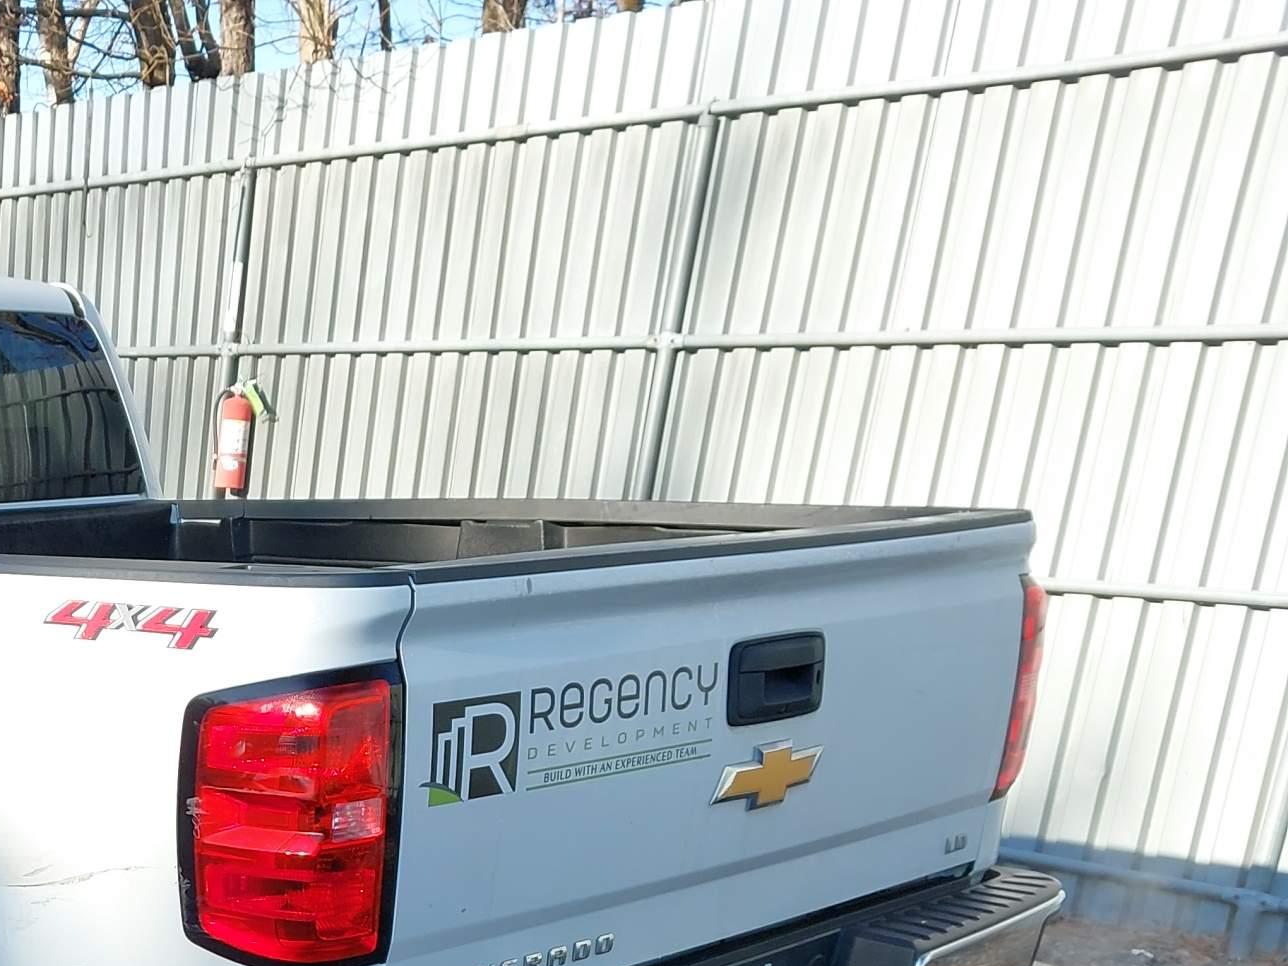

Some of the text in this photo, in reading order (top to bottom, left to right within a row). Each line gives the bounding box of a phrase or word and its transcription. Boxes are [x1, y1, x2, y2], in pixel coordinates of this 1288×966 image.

[527, 716, 713, 761] DEVELOPMENT
[543, 746, 697, 783] BUILD WITH AN EXPERIENCED TEAM
